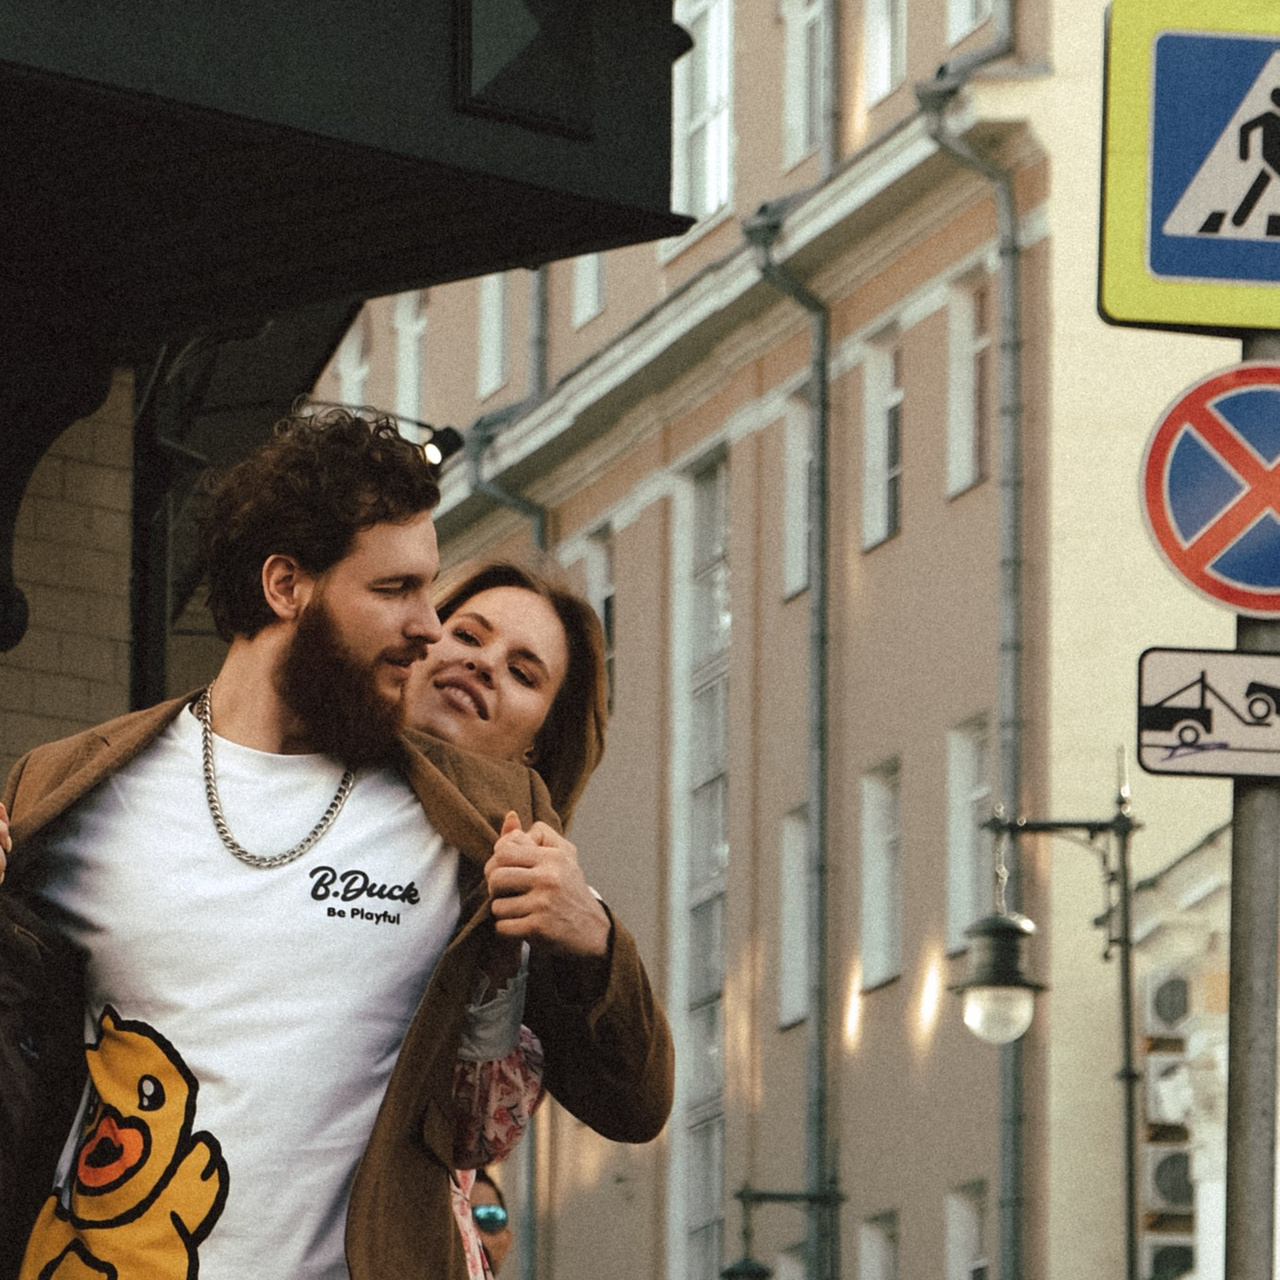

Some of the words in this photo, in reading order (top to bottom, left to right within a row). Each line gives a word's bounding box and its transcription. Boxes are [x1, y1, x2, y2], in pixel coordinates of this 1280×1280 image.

[309, 865, 420, 905] B.Duck
[327, 907, 346, 917] Be
[351, 908, 400, 924] Playful
